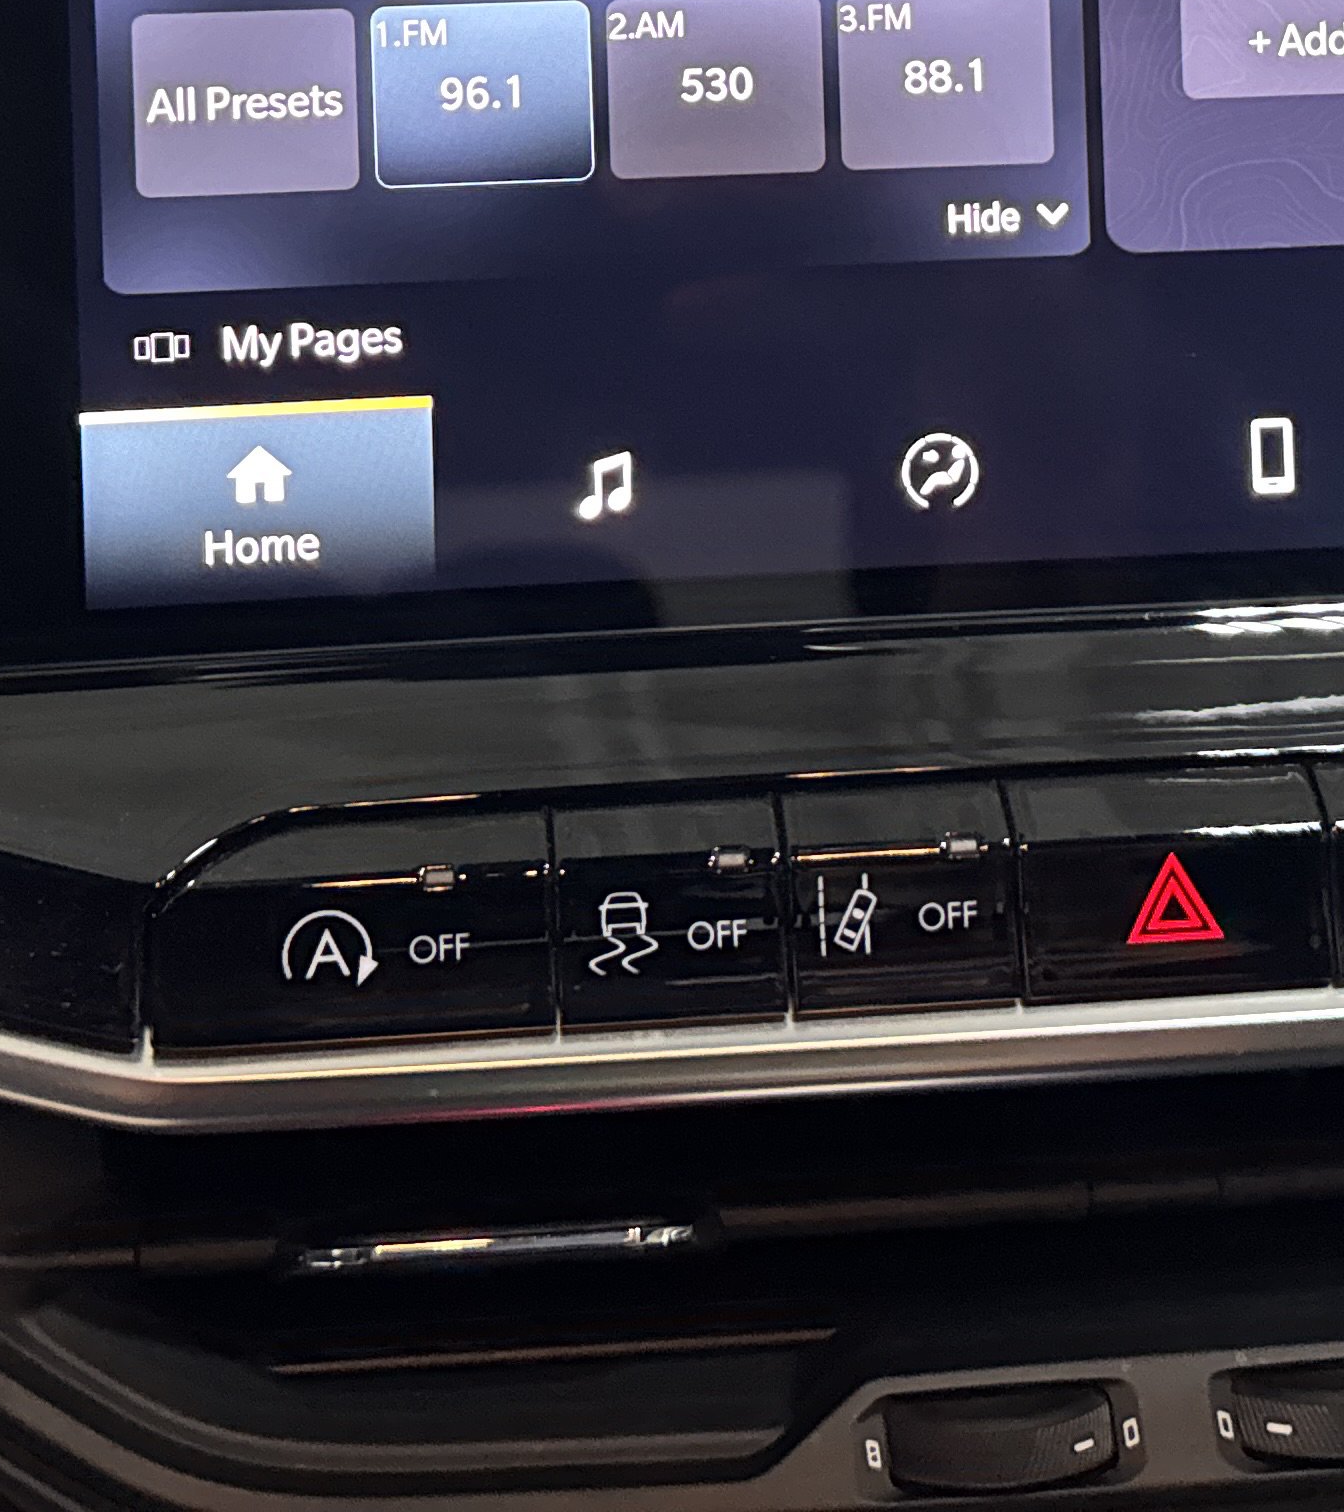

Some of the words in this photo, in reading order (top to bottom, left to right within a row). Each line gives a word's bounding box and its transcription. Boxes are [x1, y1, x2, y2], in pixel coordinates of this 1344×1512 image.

[375, 17, 448, 48] 1.FM
[606, 9, 686, 42] 2.AM
[838, 1, 913, 34] 3.FM
[439, 73, 521, 113] 96.1
[679, 65, 755, 104] 530
[903, 56, 984, 96] 88.1
[144, 85, 197, 125] All
[205, 83, 345, 122] Presets
[946, 199, 1022, 236] Hide
[221, 323, 284, 369] My
[288, 321, 404, 365] Pages
[203, 528, 321, 568] Home
[686, 918, 749, 951] OFF
[917, 899, 978, 932] OFF
[304, 927, 351, 981] A
[408, 931, 471, 965] OFF
